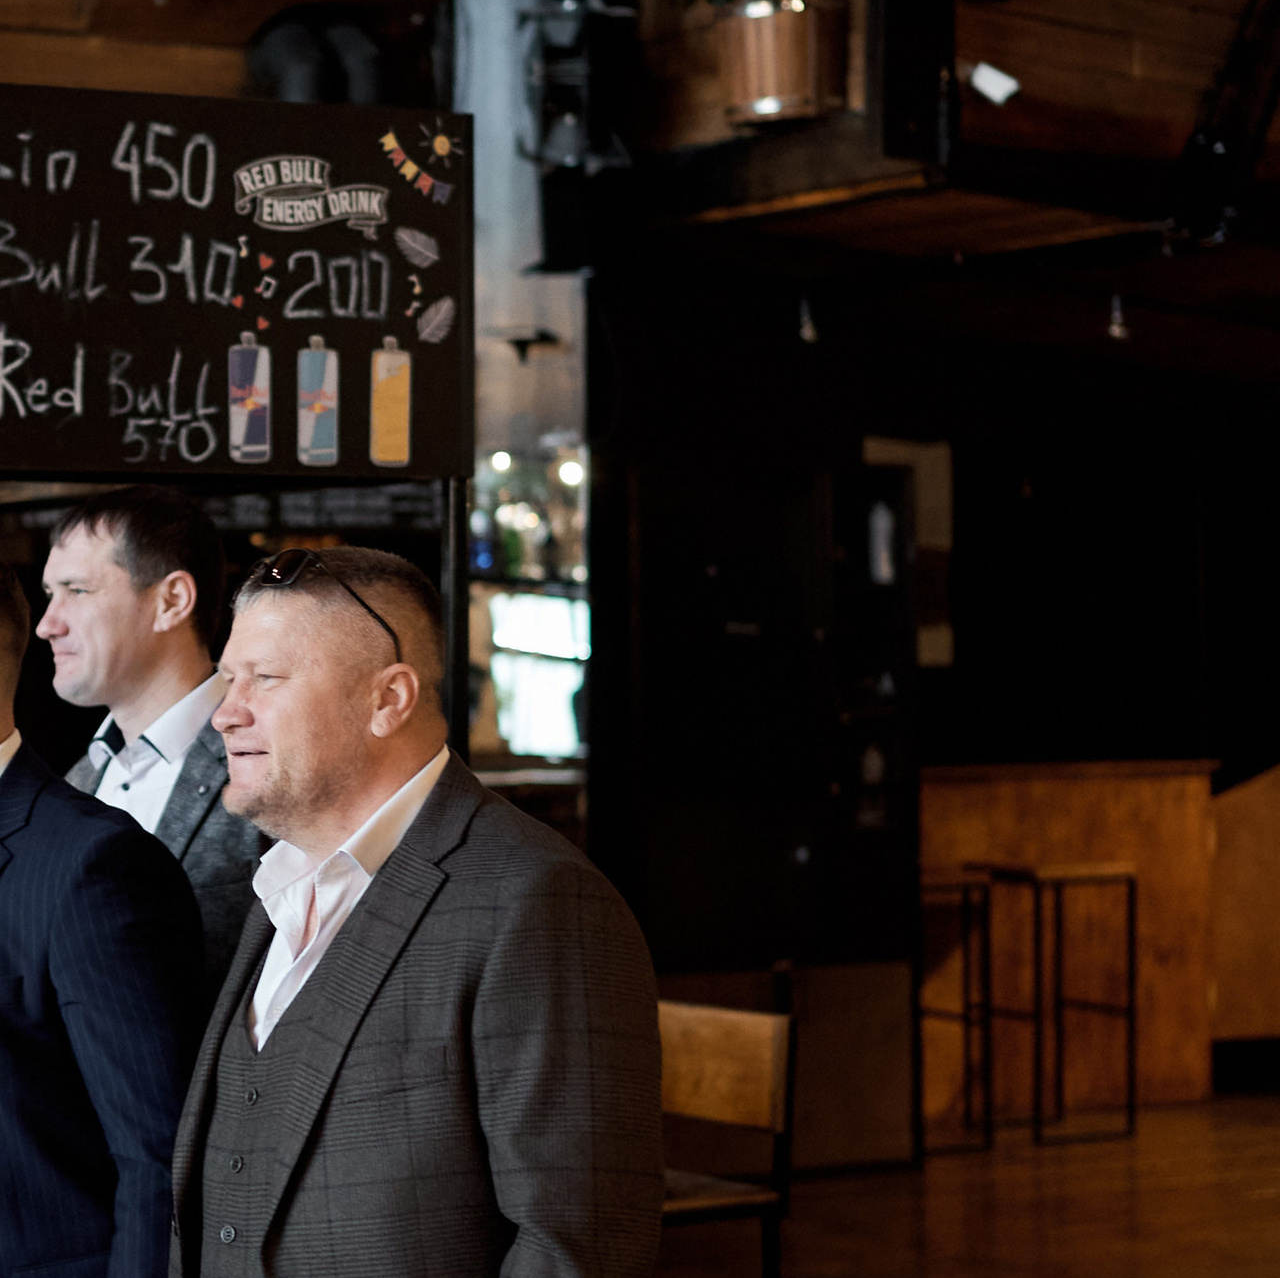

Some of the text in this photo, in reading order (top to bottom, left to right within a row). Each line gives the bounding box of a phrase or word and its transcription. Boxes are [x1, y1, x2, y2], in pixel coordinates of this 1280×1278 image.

[112, 122, 216, 209] 450
[239, 160, 323, 194] RED BULL
[262, 191, 382, 223] ENERGY DRINK
[128, 234, 237, 305] 310
[284, 250, 389, 319] 200
[122, 419, 217, 463] 570
